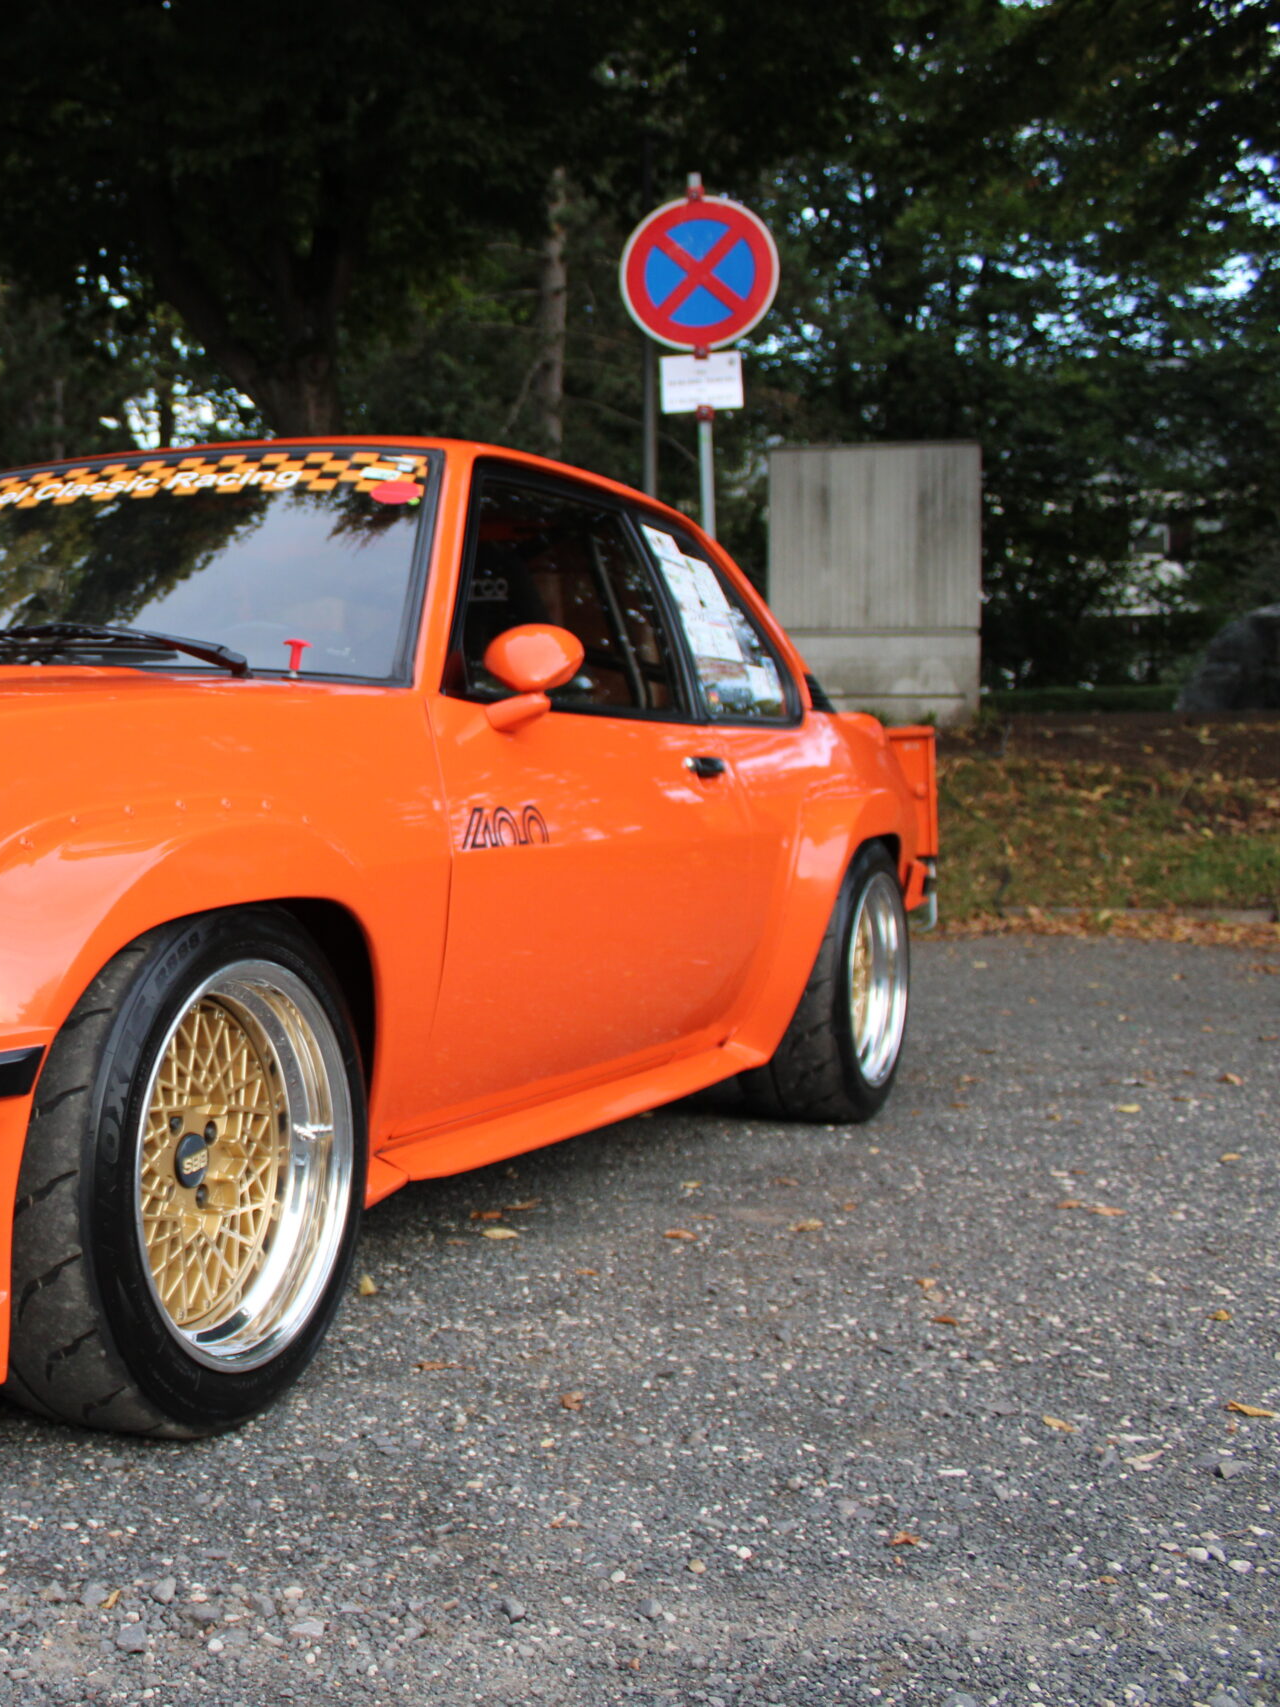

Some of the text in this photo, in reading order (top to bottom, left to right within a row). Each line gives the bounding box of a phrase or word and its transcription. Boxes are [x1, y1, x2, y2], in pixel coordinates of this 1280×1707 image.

[34, 475, 159, 501] Classic
[164, 469, 303, 489] Racing
[182, 1149, 208, 1175] BBS
